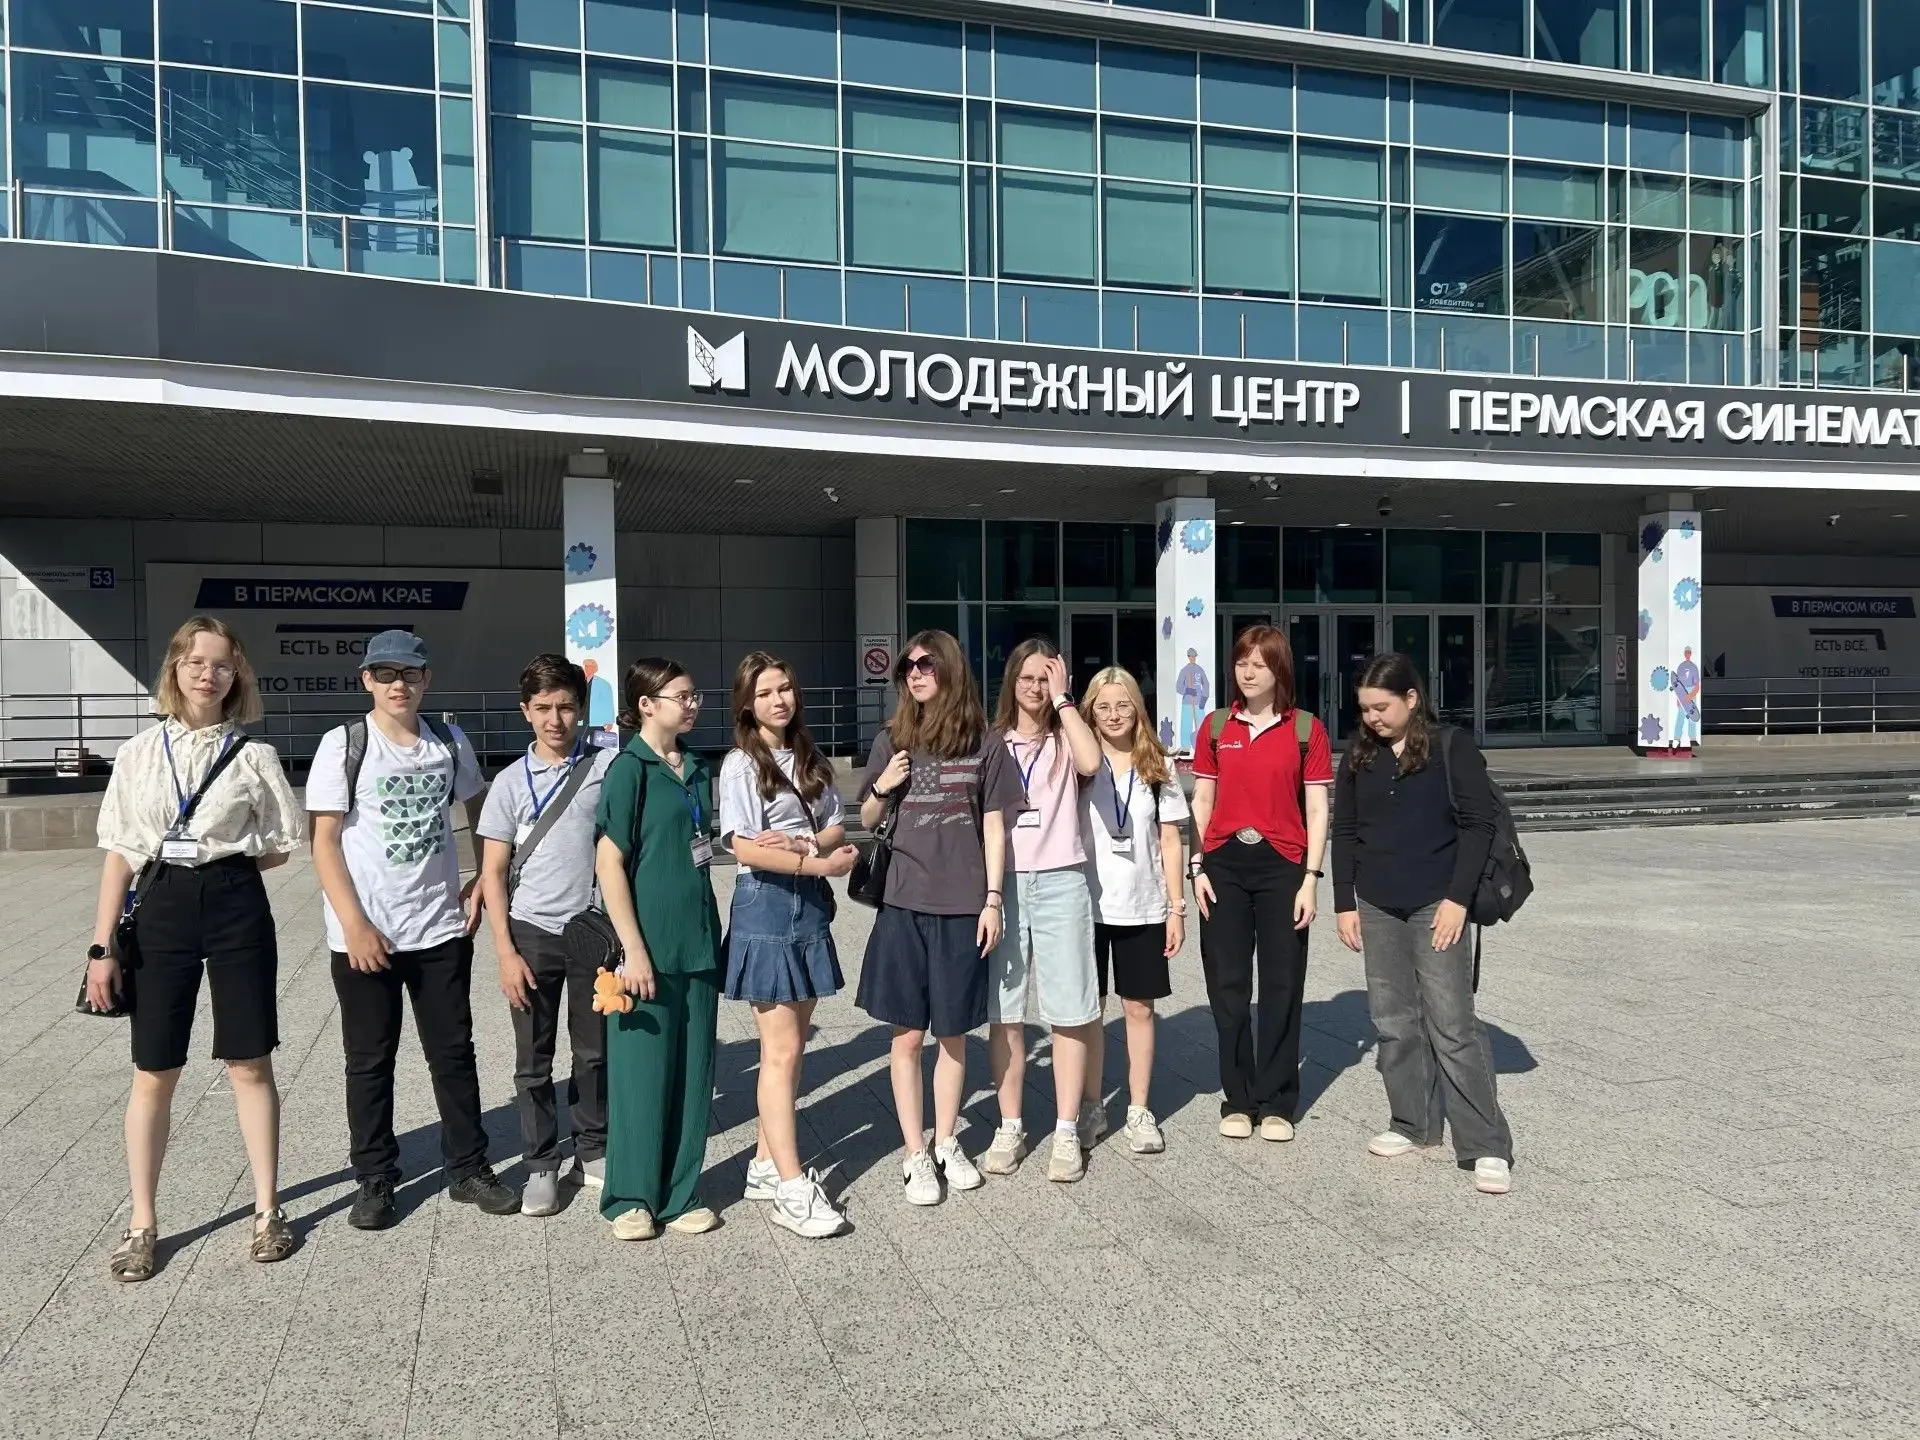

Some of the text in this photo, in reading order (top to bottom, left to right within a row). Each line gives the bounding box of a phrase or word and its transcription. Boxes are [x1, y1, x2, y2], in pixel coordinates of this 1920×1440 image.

[1429, 298, 1474, 307] ПОБЕДИТЕЛЬ
[775, 340, 1193, 418] МОЛОДЕЖНЫЙ
[1210, 374, 1361, 427] ЦЕНТР
[1449, 388, 1705, 440] ПЕРМСКАЯ
[1717, 401, 1920, 446] СИНЕМАТ
[92, 570, 112, 585] 53
[234, 586, 433, 604] В ПЕРМСКОМ КРАЕ
[1791, 600, 1897, 614] В ПЕРМСКОМ КРАЕ
[279, 639, 330, 656] ЕСТЬ
[1814, 640, 1842, 652] ЕСТЬ
[1798, 667, 1891, 678] ЧТО ТЕБЕ НУЖНО
[294, 677, 338, 692] ТЕБЕ
